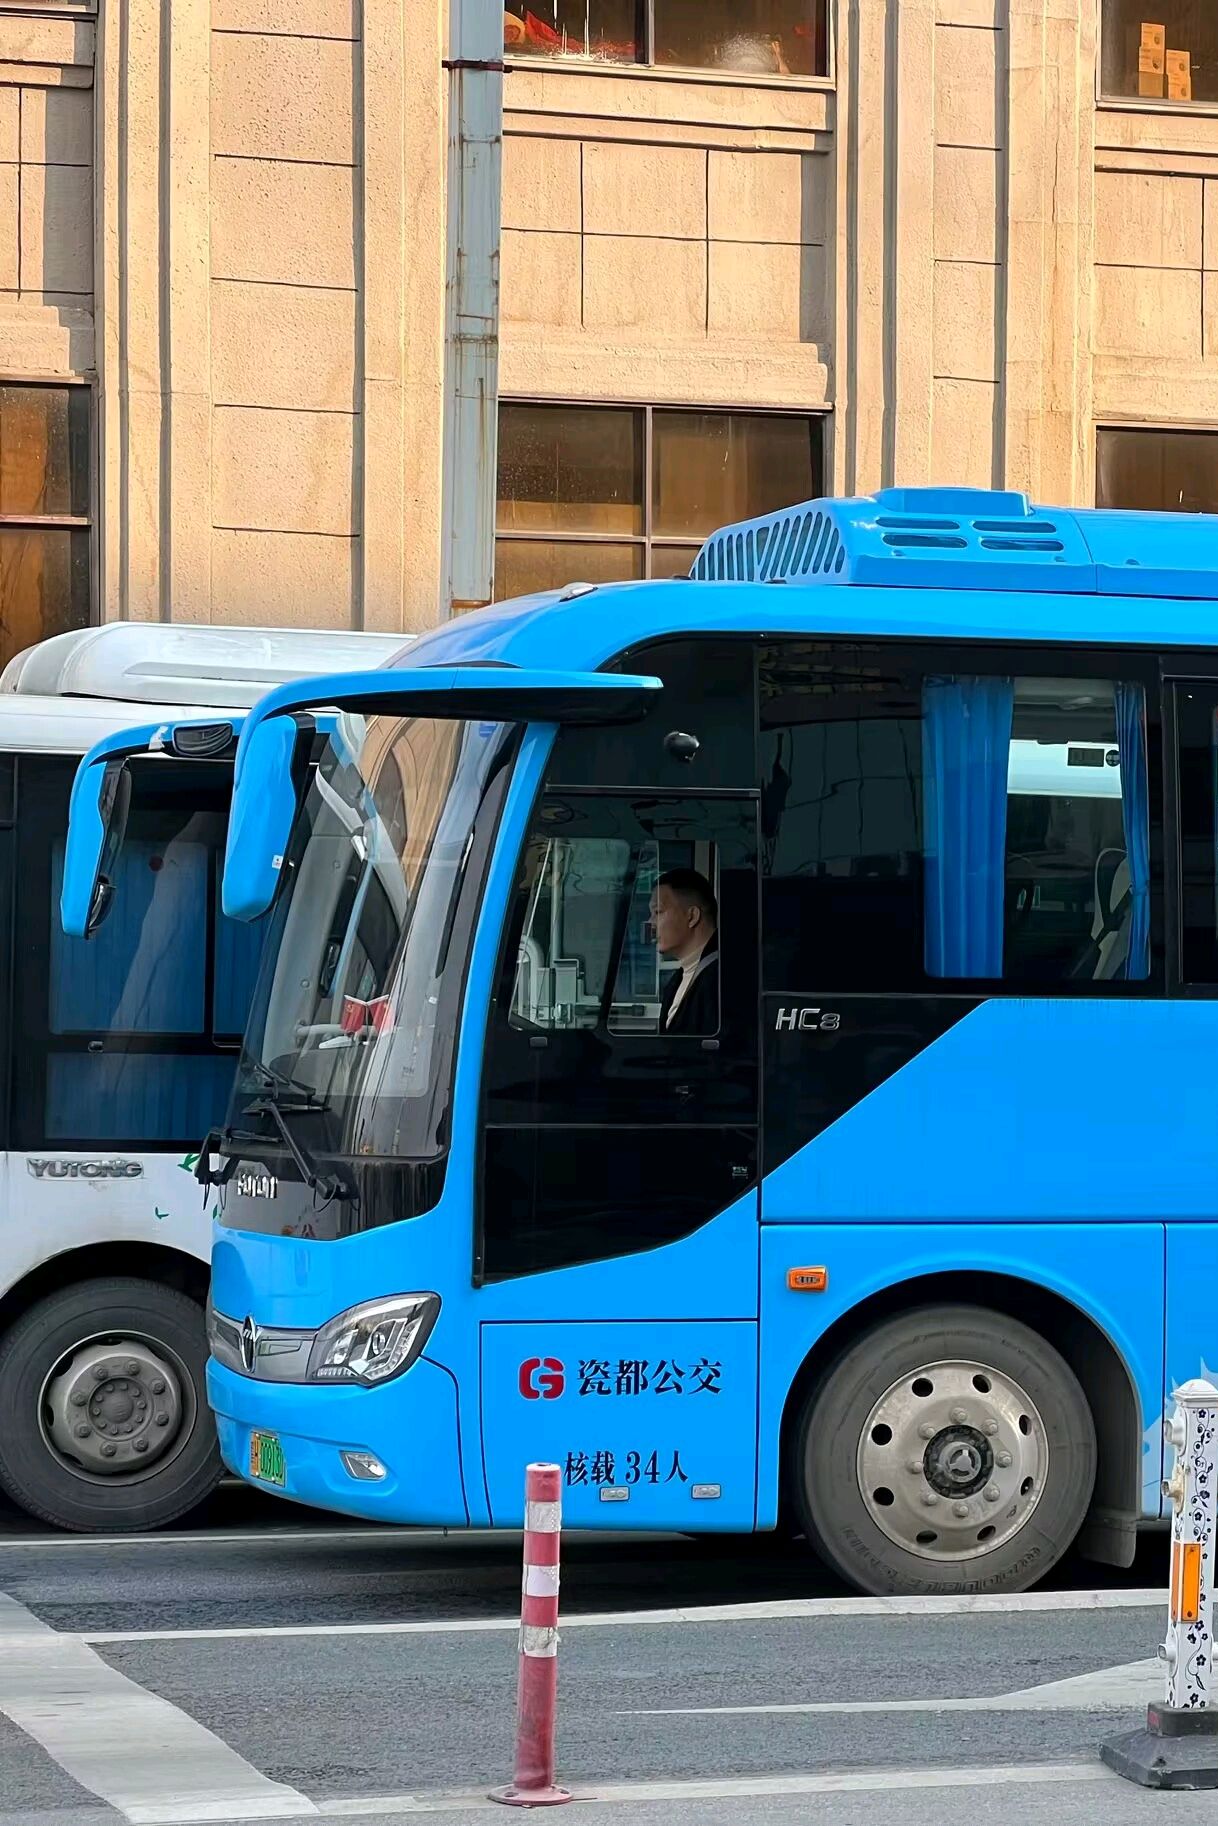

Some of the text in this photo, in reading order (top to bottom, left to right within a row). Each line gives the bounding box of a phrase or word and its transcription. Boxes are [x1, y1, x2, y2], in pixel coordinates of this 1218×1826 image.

[775, 1007, 841, 1031] HC8
[27, 1157, 144, 1178] YUTONG
[576, 1356, 723, 1397] 瓷都公交
